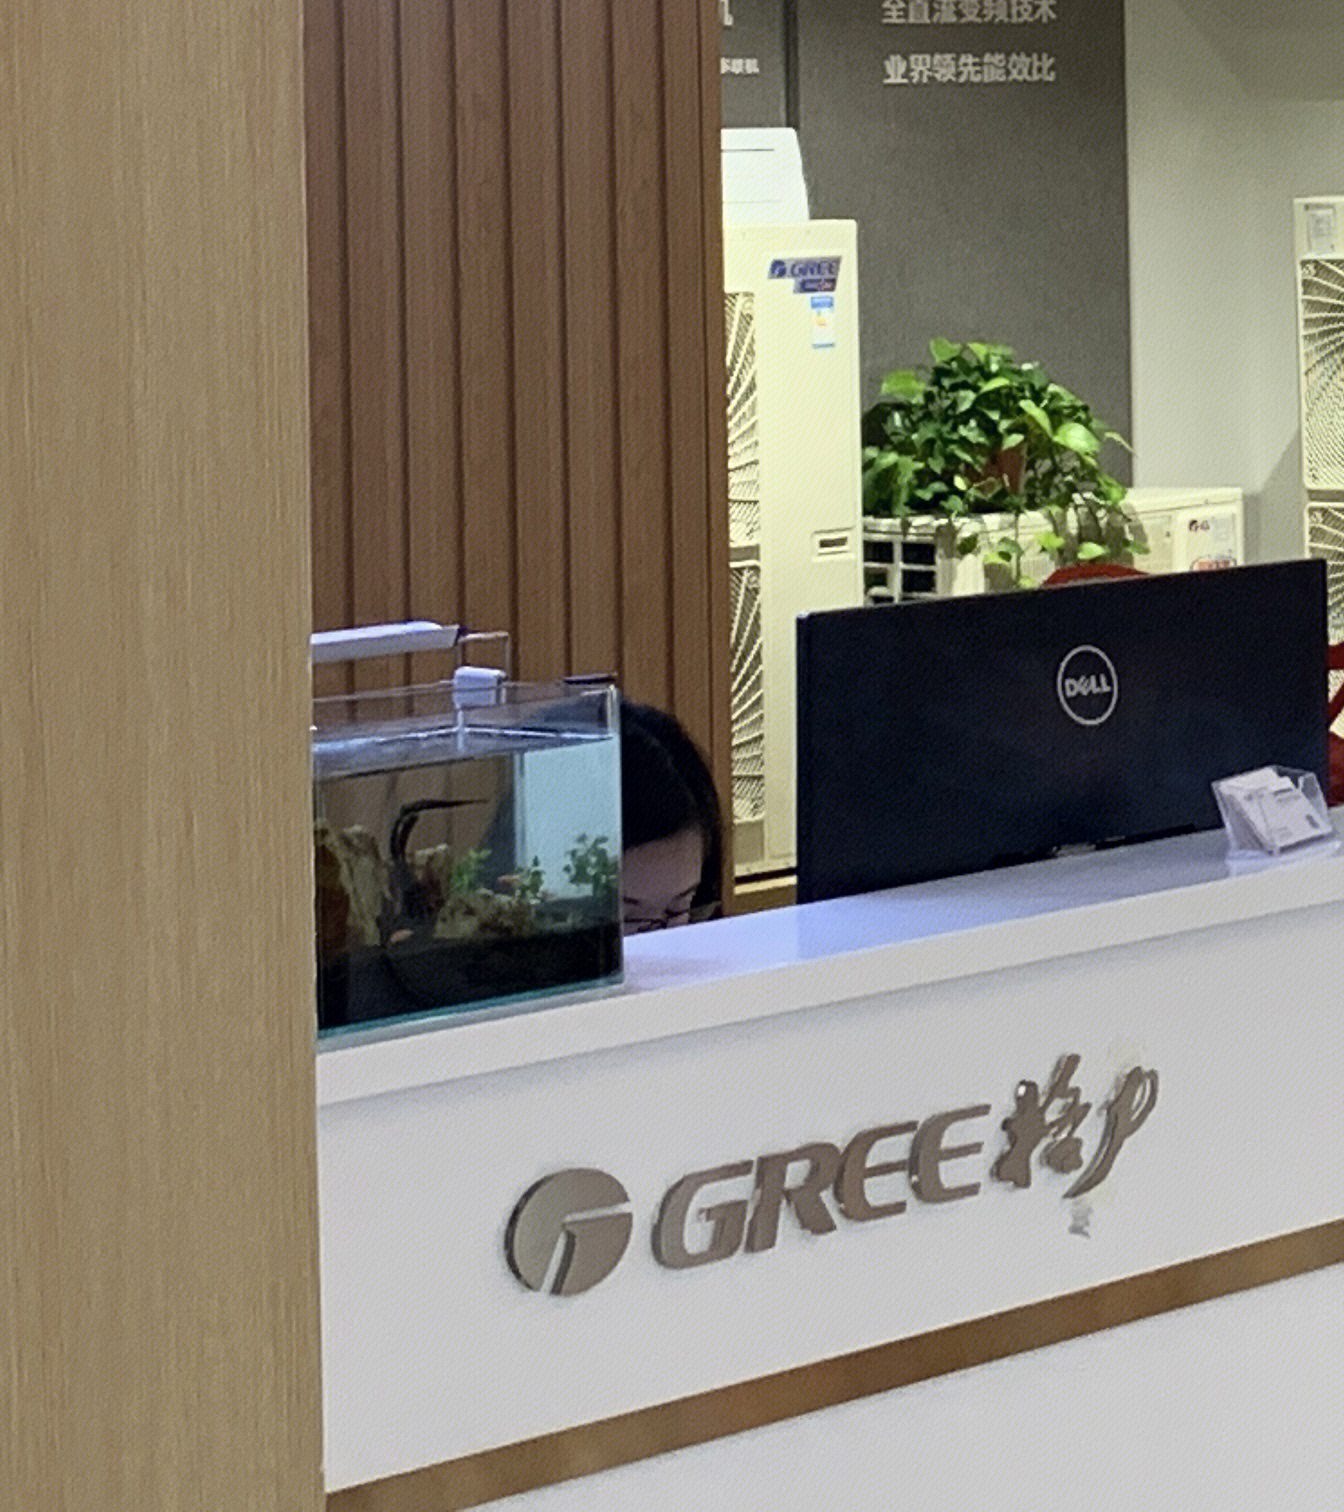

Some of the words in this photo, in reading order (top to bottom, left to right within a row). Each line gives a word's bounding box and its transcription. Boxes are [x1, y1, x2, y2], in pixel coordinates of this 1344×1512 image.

[882, 52, 1057, 84] 业界领先能效比
[1064, 673, 1111, 698] DELL
[652, 1104, 991, 1270] GREE
